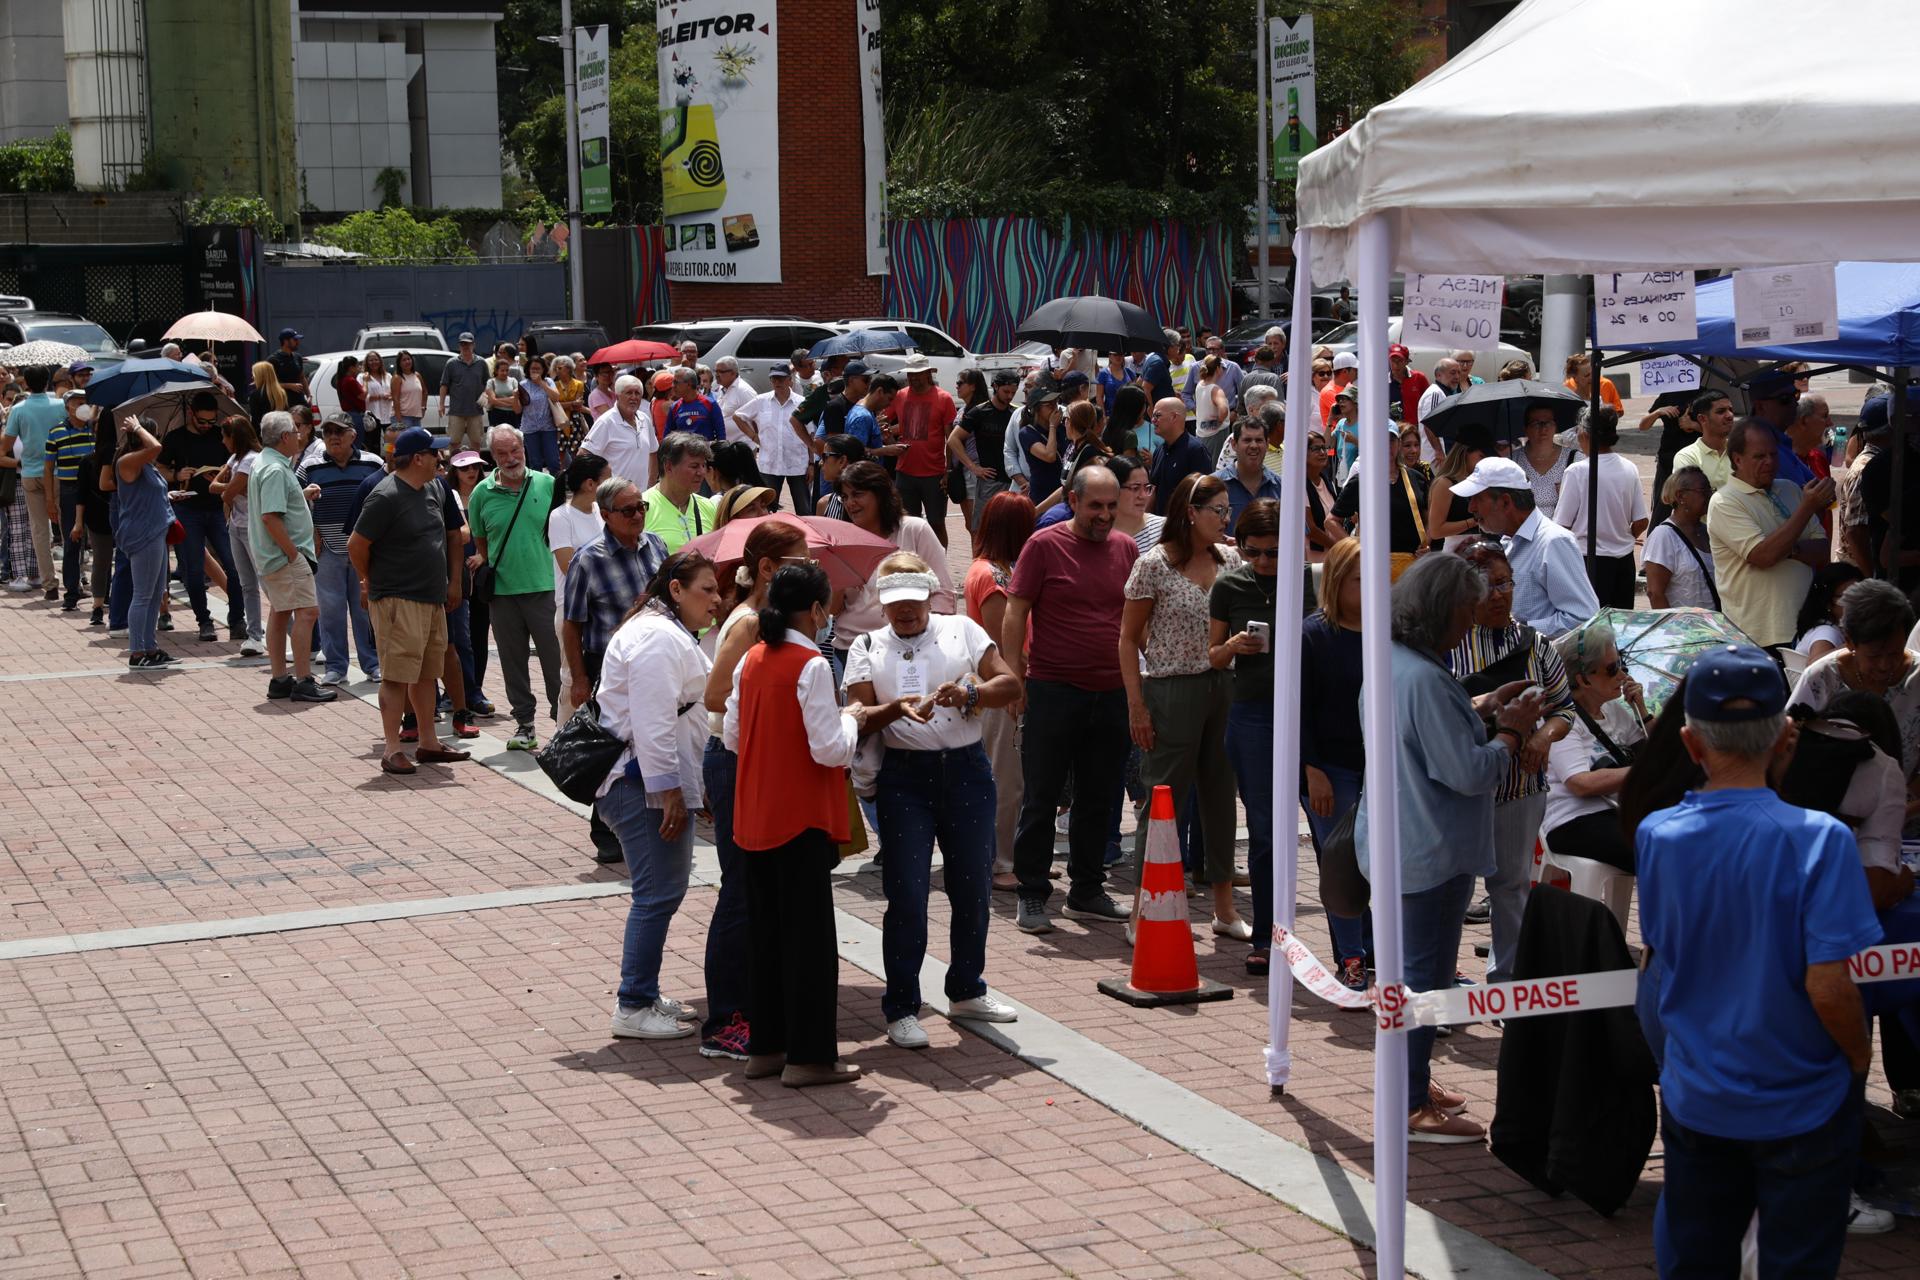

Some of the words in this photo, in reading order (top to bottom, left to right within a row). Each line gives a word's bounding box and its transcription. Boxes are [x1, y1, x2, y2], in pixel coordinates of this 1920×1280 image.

[1274, 40, 1310, 60] BICHOS
[1845, 950, 1884, 978] NO
[1468, 987, 1506, 1016] NO
[1513, 980, 1580, 1011] PASE
